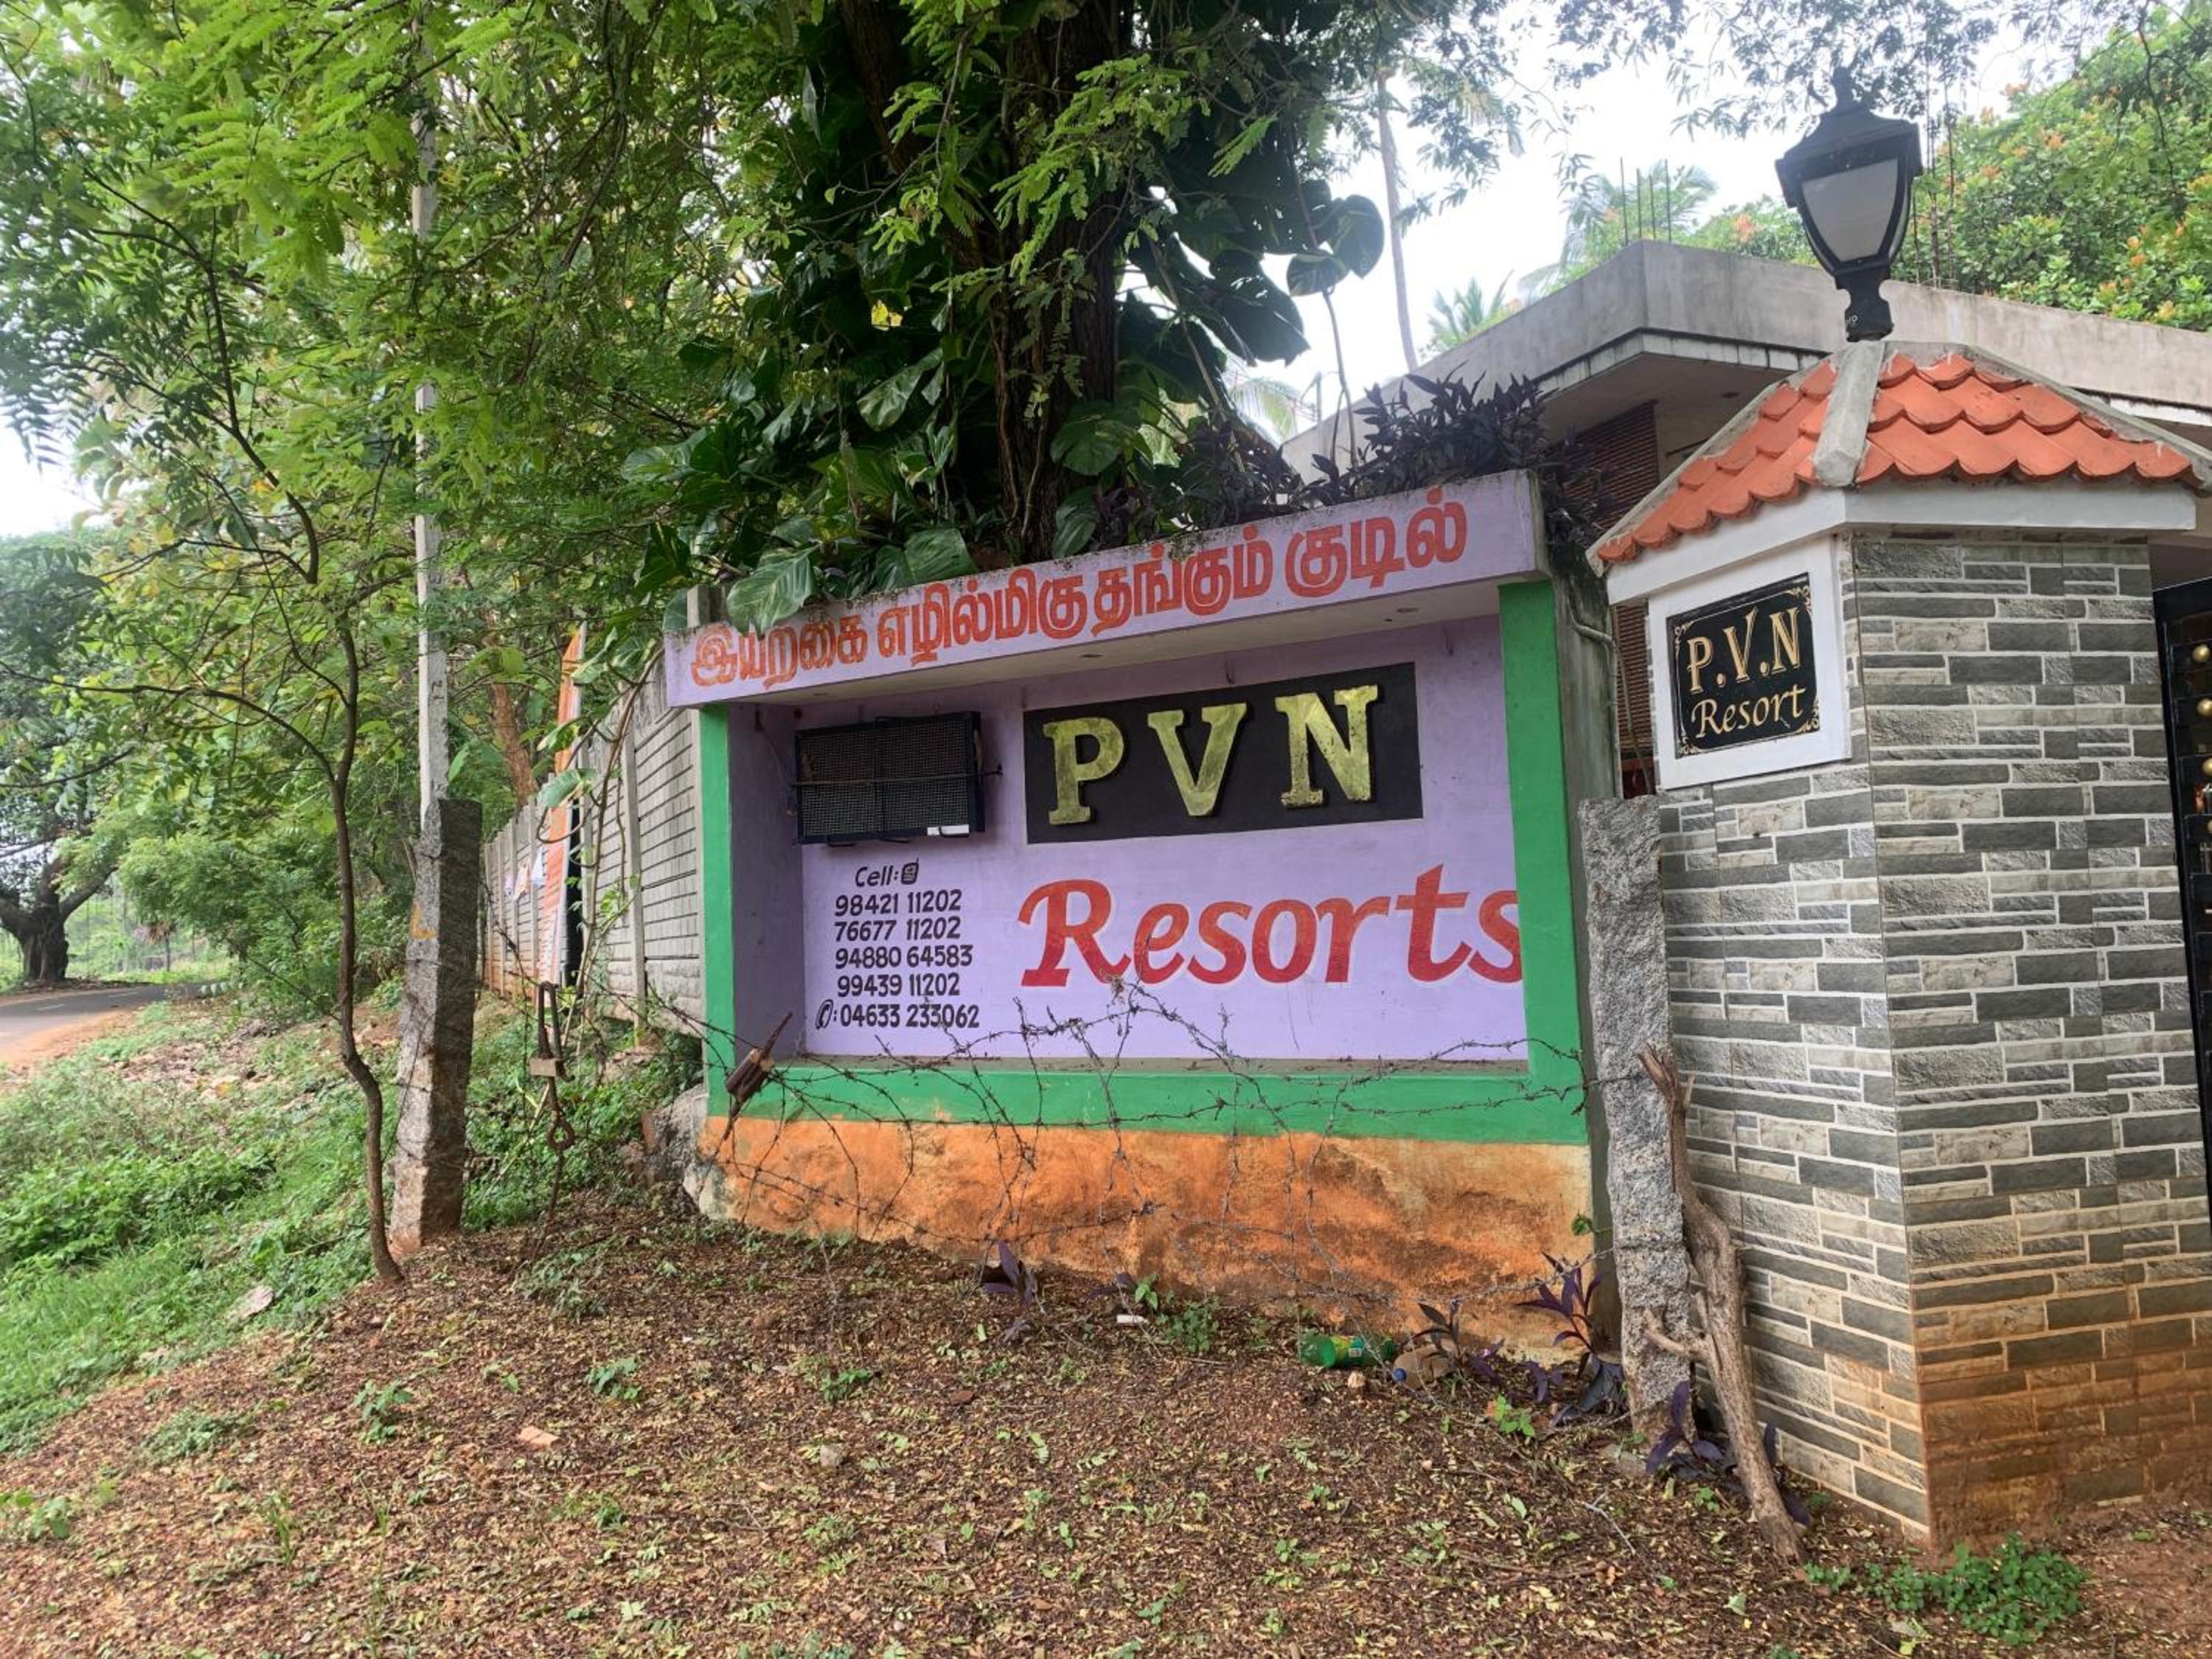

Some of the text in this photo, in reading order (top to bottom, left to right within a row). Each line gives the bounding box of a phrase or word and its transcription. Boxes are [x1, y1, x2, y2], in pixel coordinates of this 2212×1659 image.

[1285, 484, 1468, 598] குடில்
[1691, 684, 1806, 738] Resort
[835, 888, 962, 917] 98421 11202
[834, 916, 961, 942] 76677 11202
[1018, 863, 1523, 988] Resorts
[835, 945, 974, 970] 94880 64583
[837, 973, 961, 998] 99439 11202
[905, 1004, 980, 1029] 233062
